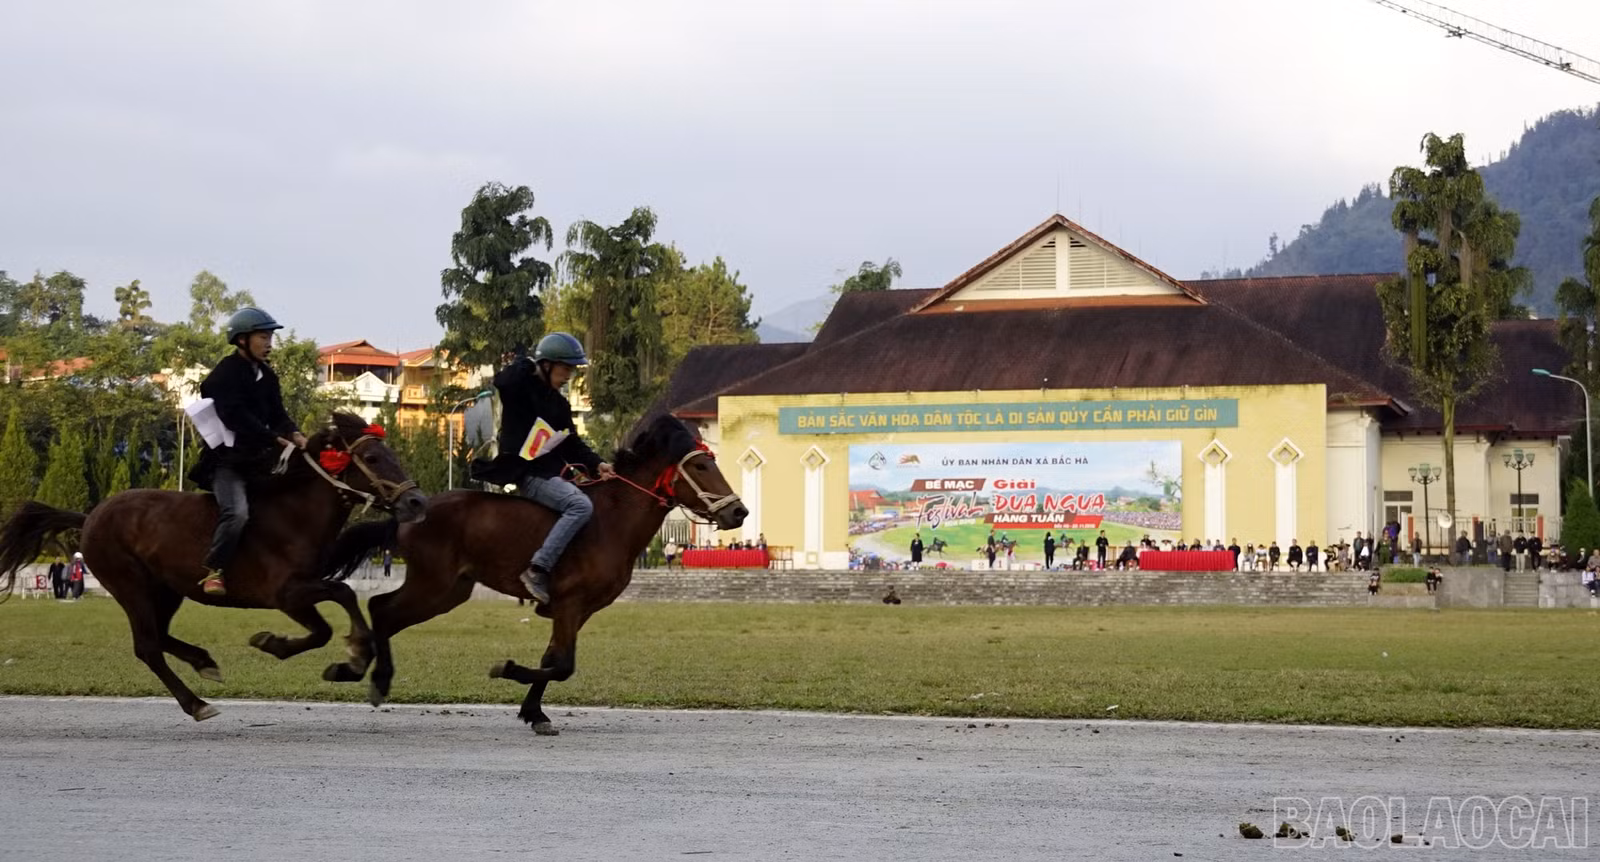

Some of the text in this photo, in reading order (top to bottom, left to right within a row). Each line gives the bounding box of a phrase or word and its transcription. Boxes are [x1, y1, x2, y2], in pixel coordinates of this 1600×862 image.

[797, 411, 825, 428] BẢN
[829, 409, 855, 428] SẮC
[859, 411, 887, 427] VĂN
[891, 410, 919, 426] HÓA
[924, 410, 952, 426] DÂN
[957, 409, 980, 429] TỘC
[986, 409, 1004, 425] LÀ
[1009, 411, 1022, 425] DI
[1027, 406, 1055, 424] SẢN
[1093, 405, 1122, 423] CẦN
[1127, 405, 1161, 422] PHẢI
[1166, 404, 1190, 422] GIỮ
[1194, 404, 1217, 421] GÌN
[981, 456, 1009, 466] NHÂN
[1012, 456, 1032, 465] DÂN
[1052, 454, 1072, 465] BẮC
[1075, 455, 1089, 465] HÀ
[944, 480, 975, 491] MẠC
[993, 512, 1027, 523] HÀNG
[38, 575, 47, 589] 3
